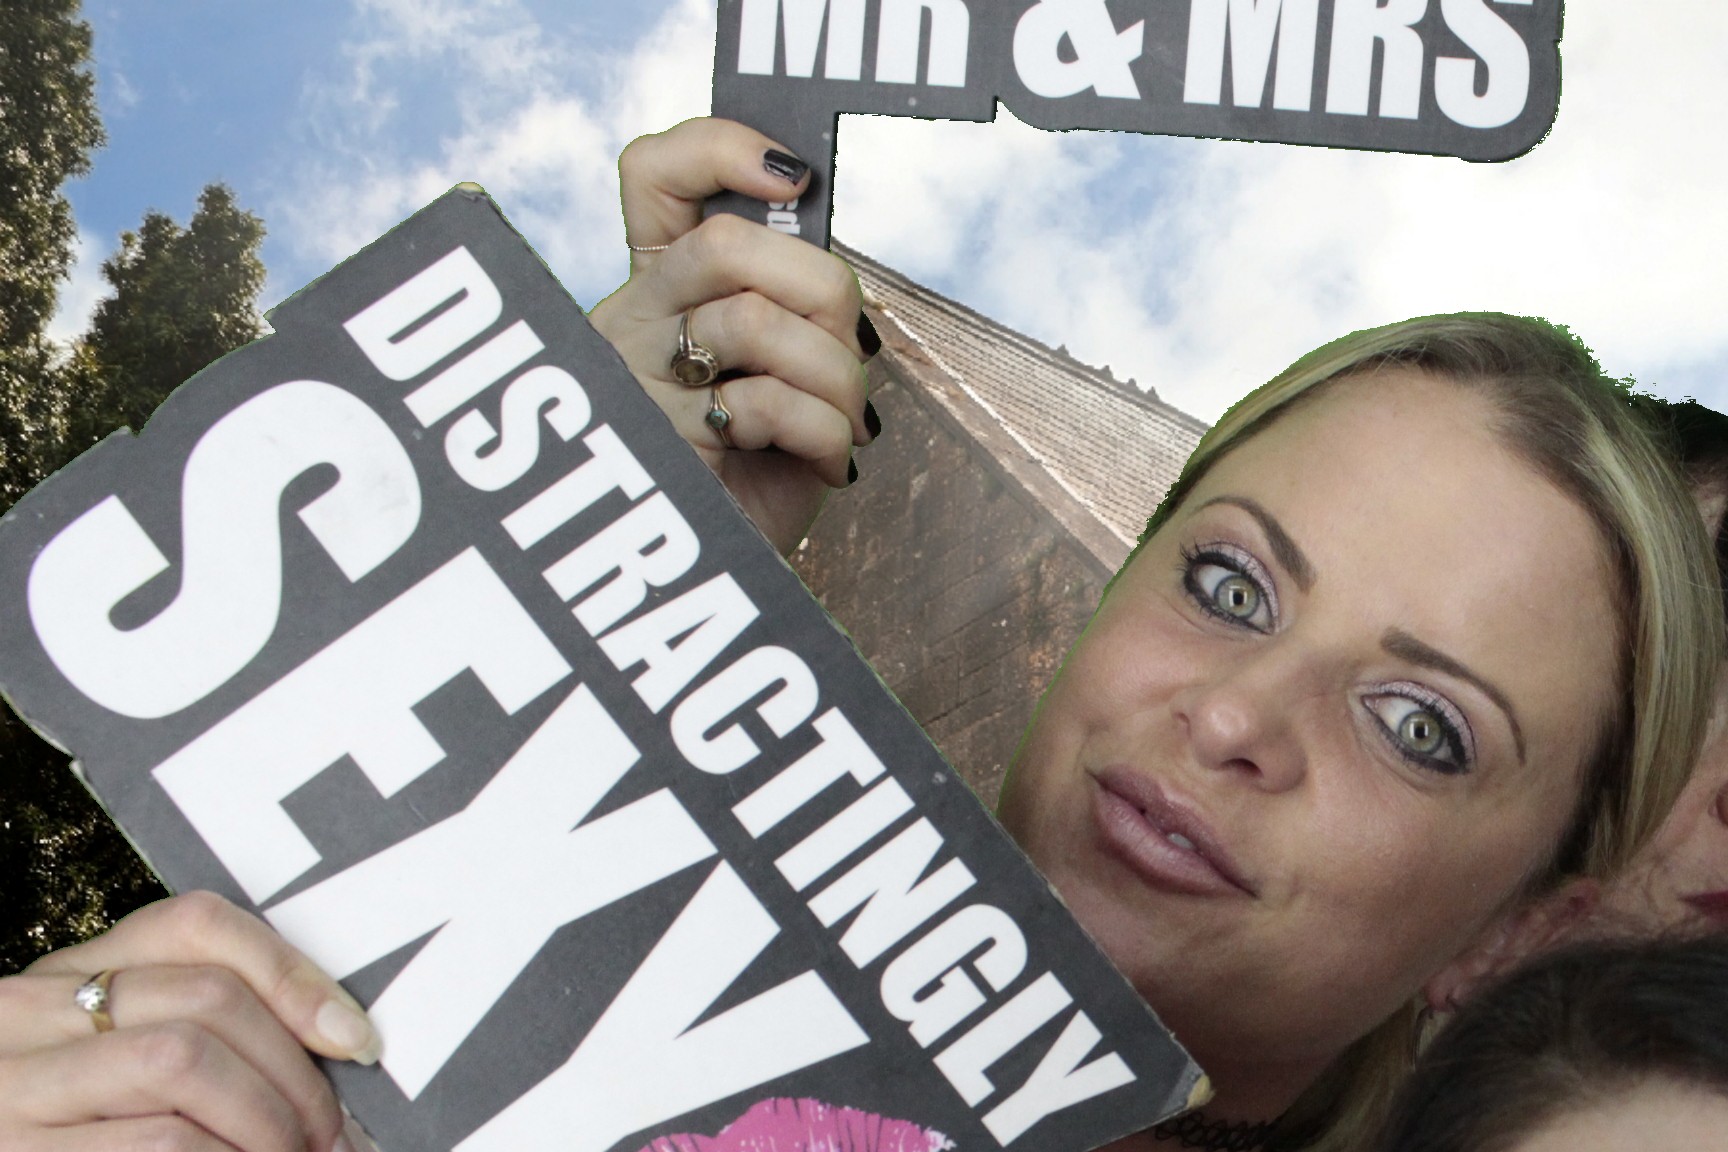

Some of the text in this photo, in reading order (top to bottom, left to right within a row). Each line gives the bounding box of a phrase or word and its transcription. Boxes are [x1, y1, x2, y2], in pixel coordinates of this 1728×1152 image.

[1012, 0, 1145, 99] &
[1183, 0, 1535, 129] MRS
[343, 245, 1138, 1148] DISTRACTINGLY
